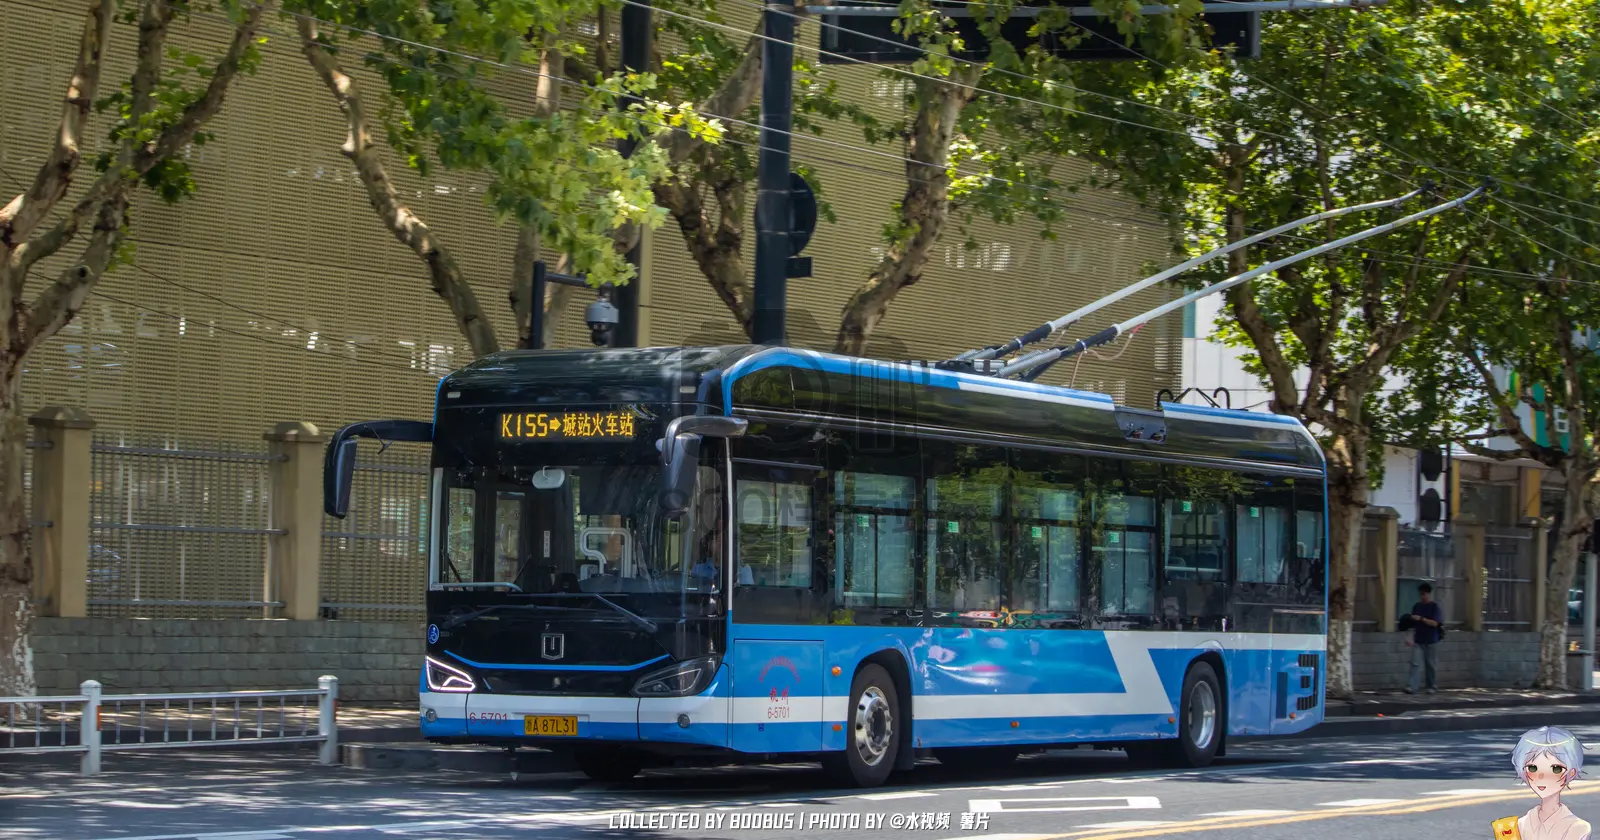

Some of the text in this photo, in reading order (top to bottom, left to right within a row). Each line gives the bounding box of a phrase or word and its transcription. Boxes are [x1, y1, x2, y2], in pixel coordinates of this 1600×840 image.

[563, 412, 633, 437] 城站火车站
[469, 712, 509, 724] 6-5701
[768, 706, 790, 719] 6-5701
